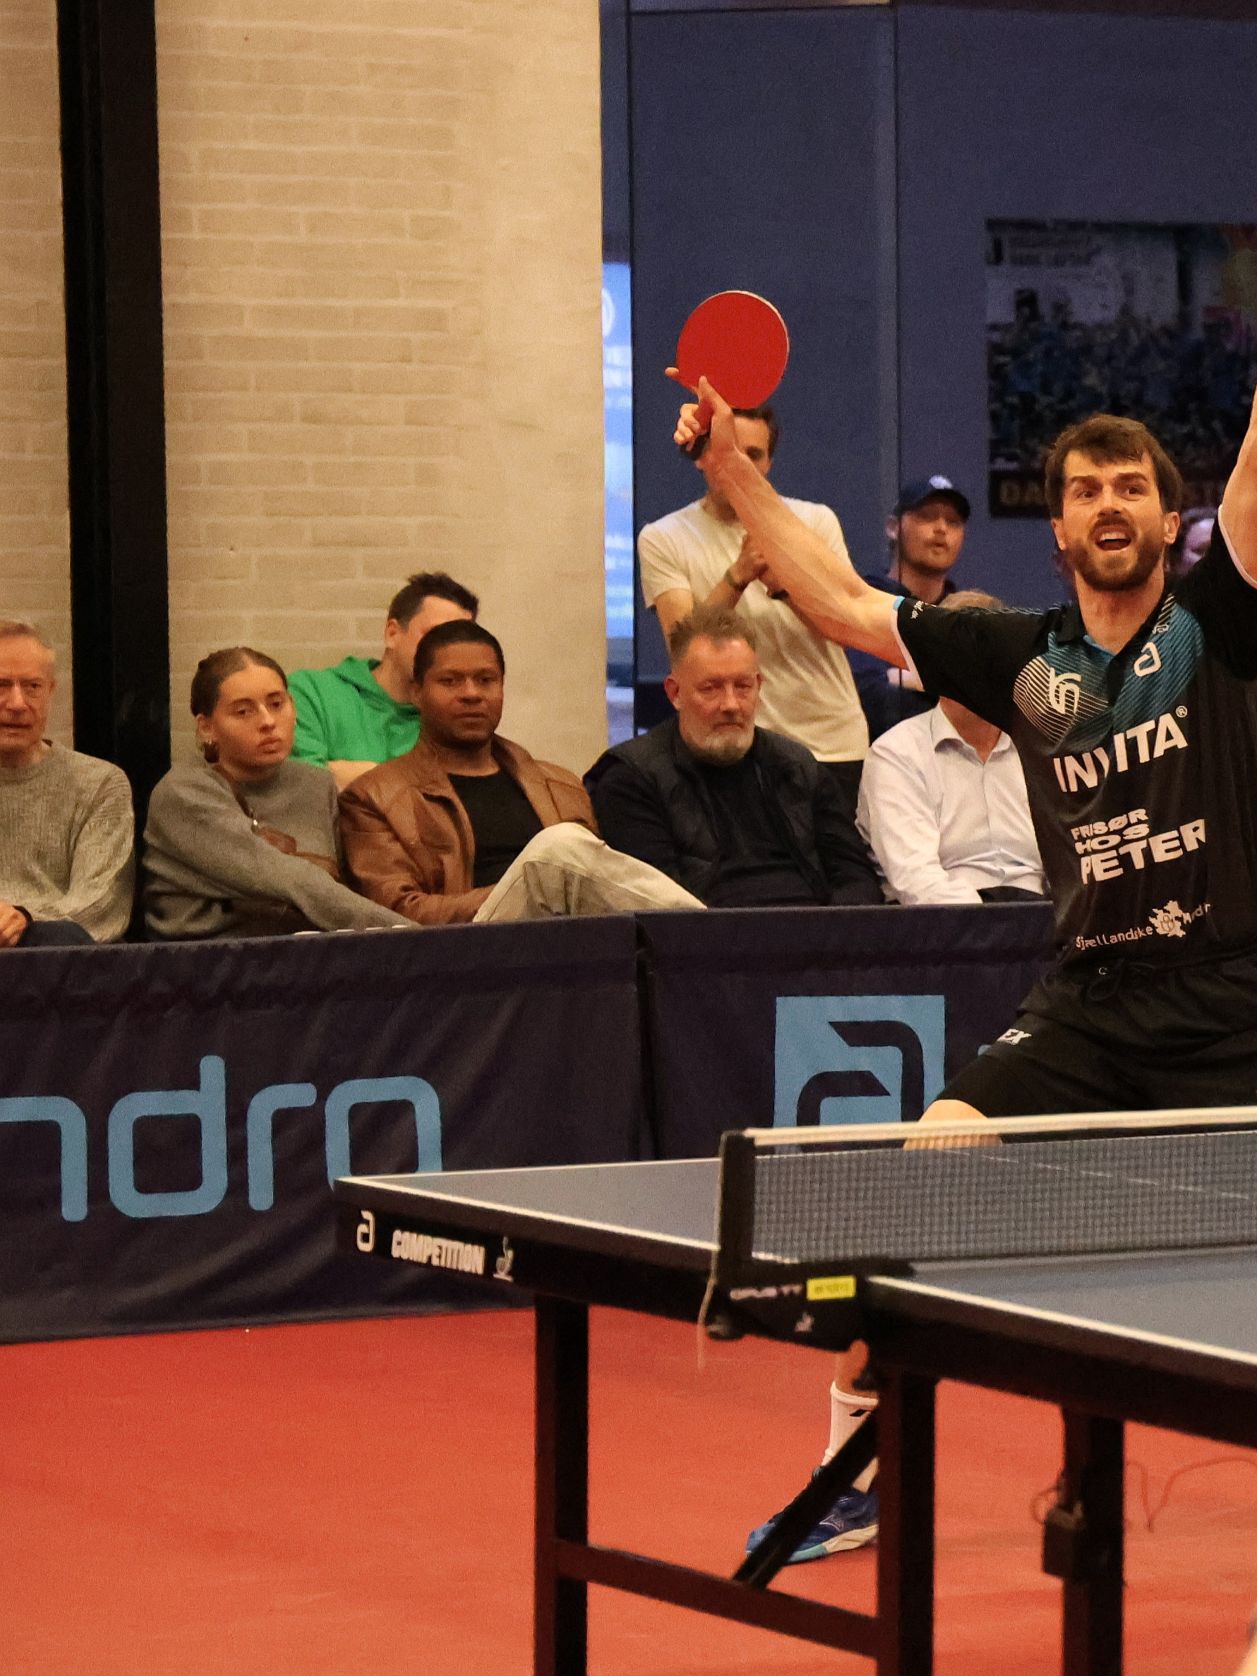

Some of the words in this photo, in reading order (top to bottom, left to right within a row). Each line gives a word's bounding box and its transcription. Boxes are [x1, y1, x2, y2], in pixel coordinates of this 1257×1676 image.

[1070, 808, 1149, 840] FRISØR
[1074, 823, 1150, 854] HOS
[1080, 818, 1206, 885] PETER
[391, 1229, 486, 1276] COMPETITION
